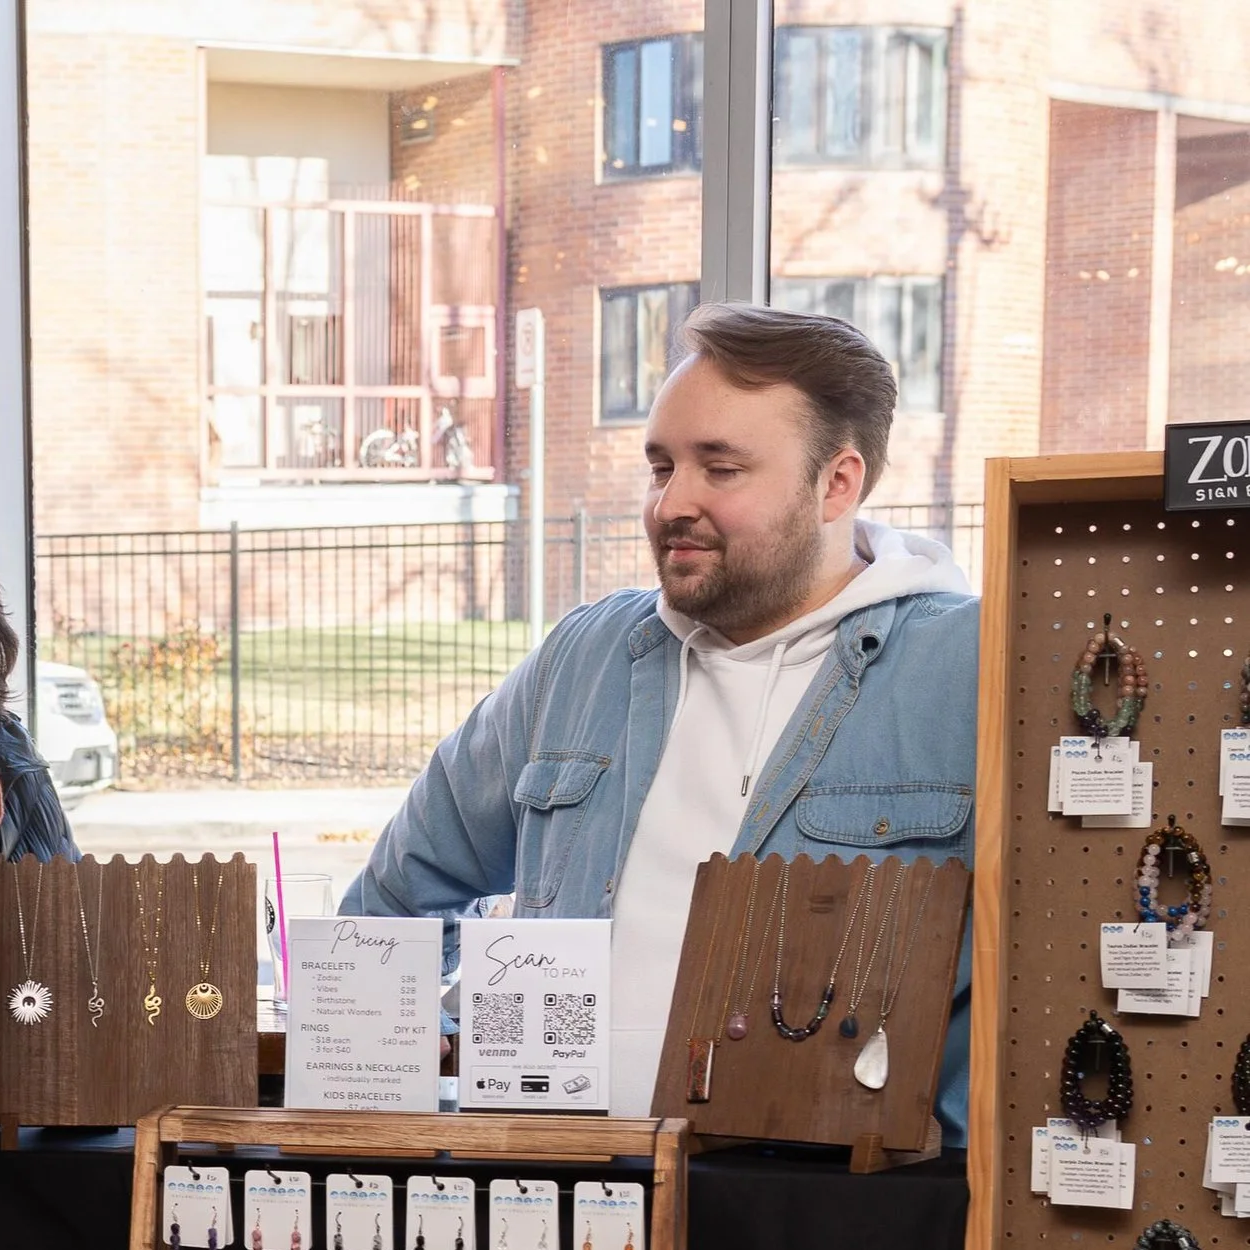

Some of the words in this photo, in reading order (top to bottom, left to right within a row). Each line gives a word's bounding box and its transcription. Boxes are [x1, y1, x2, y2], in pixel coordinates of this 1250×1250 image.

[1195, 486, 1238, 501] SIGN
[331, 920, 400, 965] Pricing
[485, 934, 556, 986] Scan
[301, 961, 356, 971] BRACELETS
[316, 974, 343, 982] Zodiac
[542, 968, 559, 978] TO
[562, 968, 587, 978] PAY
[316, 985, 338, 993] Vibes
[316, 996, 356, 1004] Birthstone
[316, 1008, 345, 1016] Natural
[347, 1009, 382, 1017] Wonders
[301, 1023, 330, 1032] RINGS
[394, 1025, 409, 1034] DIY
[412, 1026, 427, 1035] KIT
[315, 1036, 331, 1044] $18
[333, 1036, 351, 1044] each
[381, 1038, 397, 1046] $40
[399, 1038, 417, 1046] each
[335, 1046, 351, 1054] $40
[478, 1048, 518, 1057] venmo
[552, 1049, 586, 1060] PayPal
[306, 1062, 354, 1071] EARRINGS
[356, 1063, 363, 1071] &
[365, 1063, 421, 1073] NECKLACES
[488, 1079, 511, 1092] Pay
[323, 1091, 345, 1100] KIDS
[347, 1092, 402, 1101] BRACELETS
